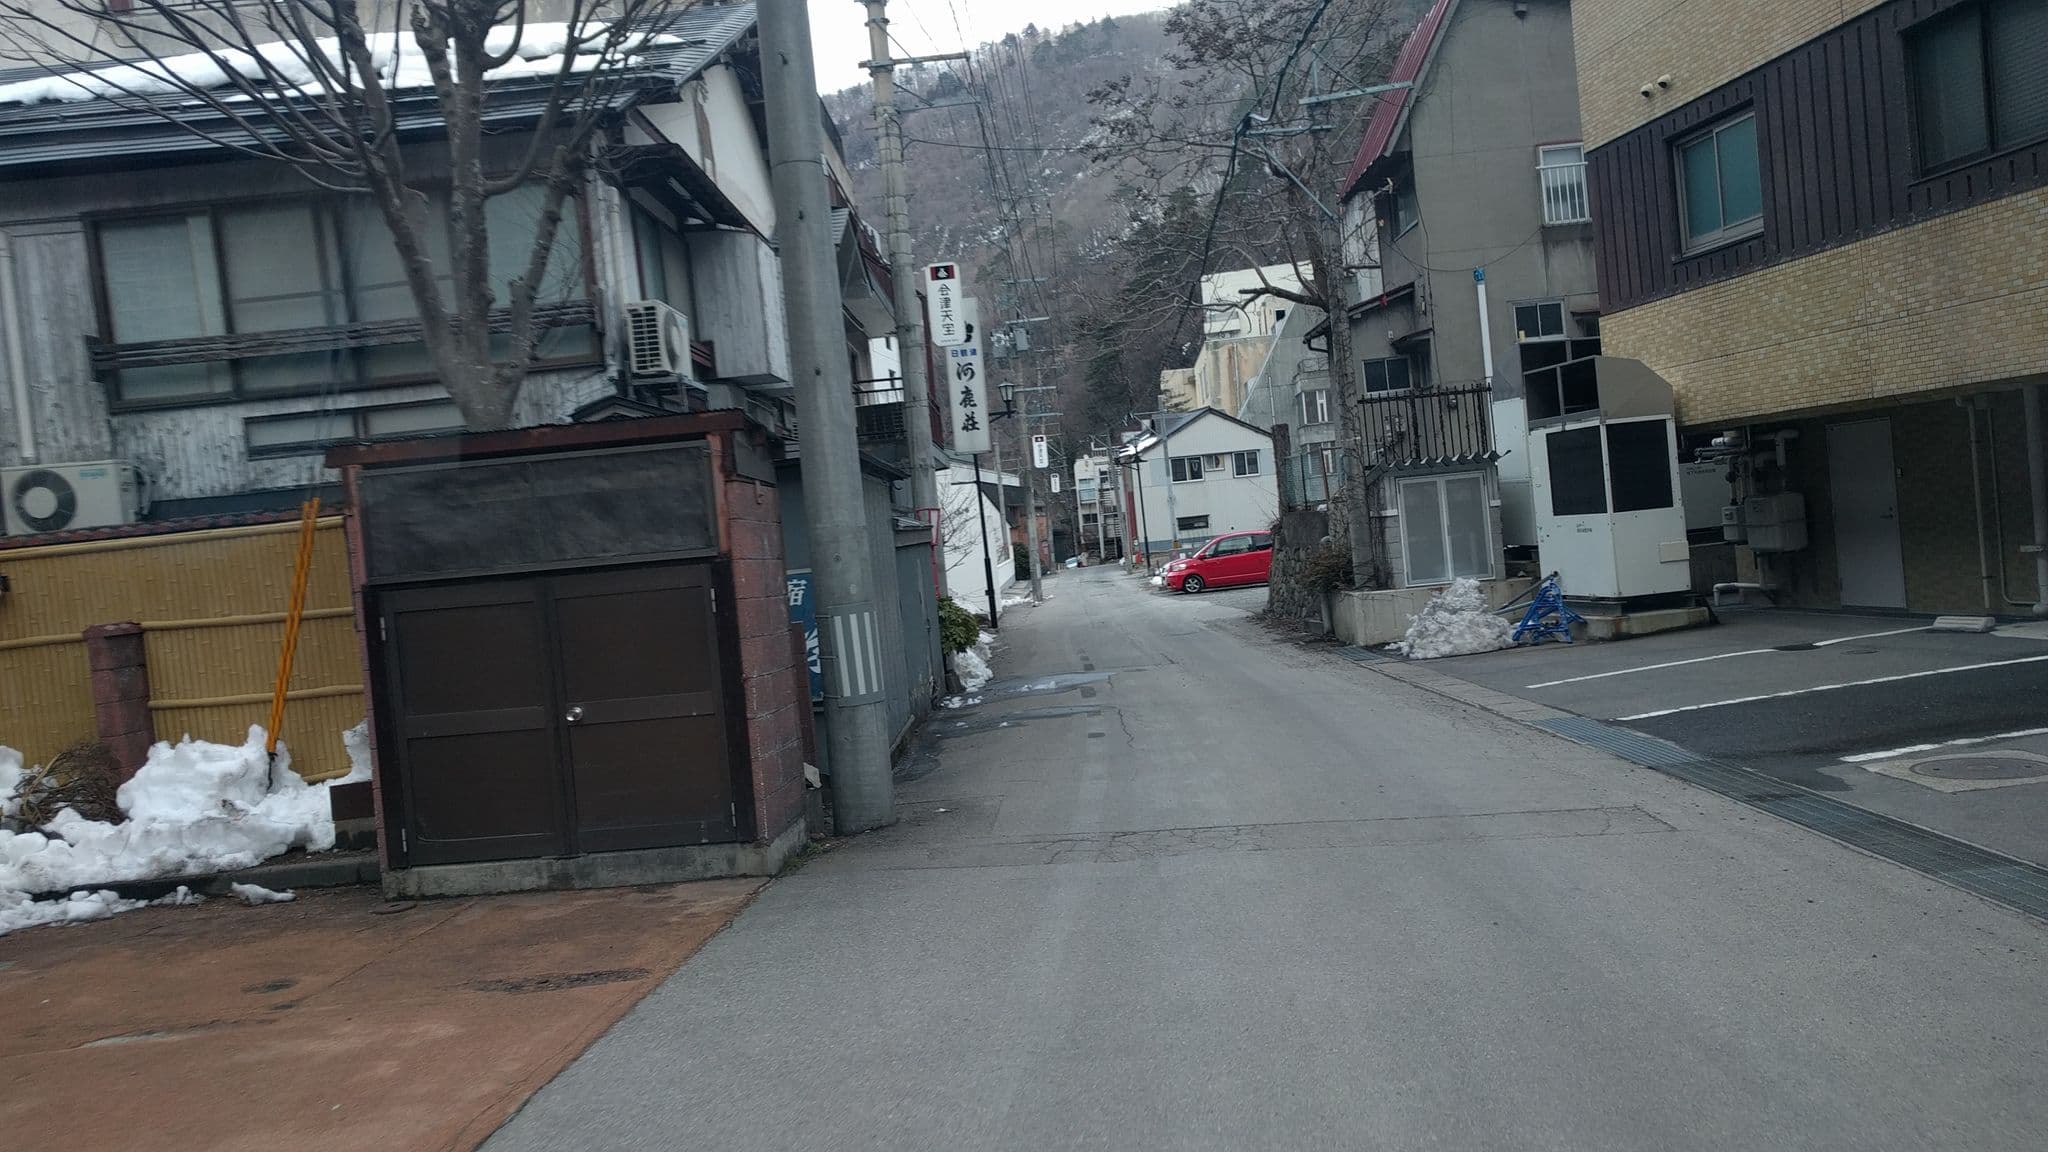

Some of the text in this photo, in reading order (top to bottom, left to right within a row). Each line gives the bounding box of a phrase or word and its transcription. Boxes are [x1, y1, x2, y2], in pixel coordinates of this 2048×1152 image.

[937, 283, 955, 336] 会津天宝
[956, 362, 980, 432] 河鹿荘
